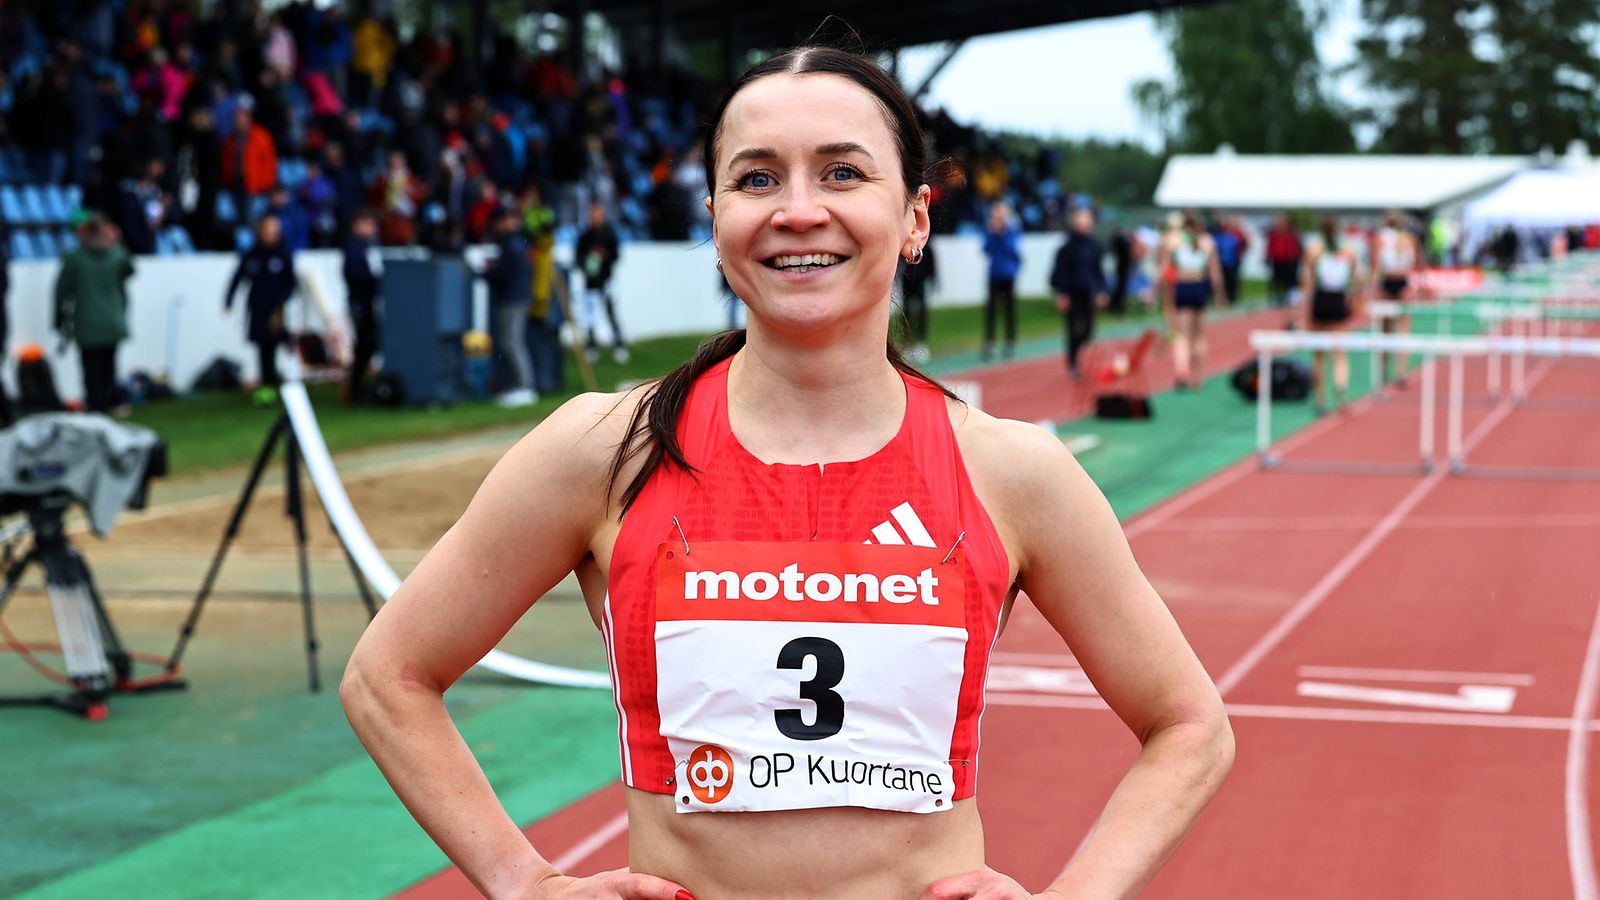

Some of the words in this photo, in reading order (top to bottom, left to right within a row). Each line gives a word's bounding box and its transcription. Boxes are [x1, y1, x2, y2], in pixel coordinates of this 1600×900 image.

[684, 562, 941, 606] motonet
[774, 636, 845, 740] 3
[749, 752, 796, 789] OP
[807, 754, 943, 796] Kuortane
